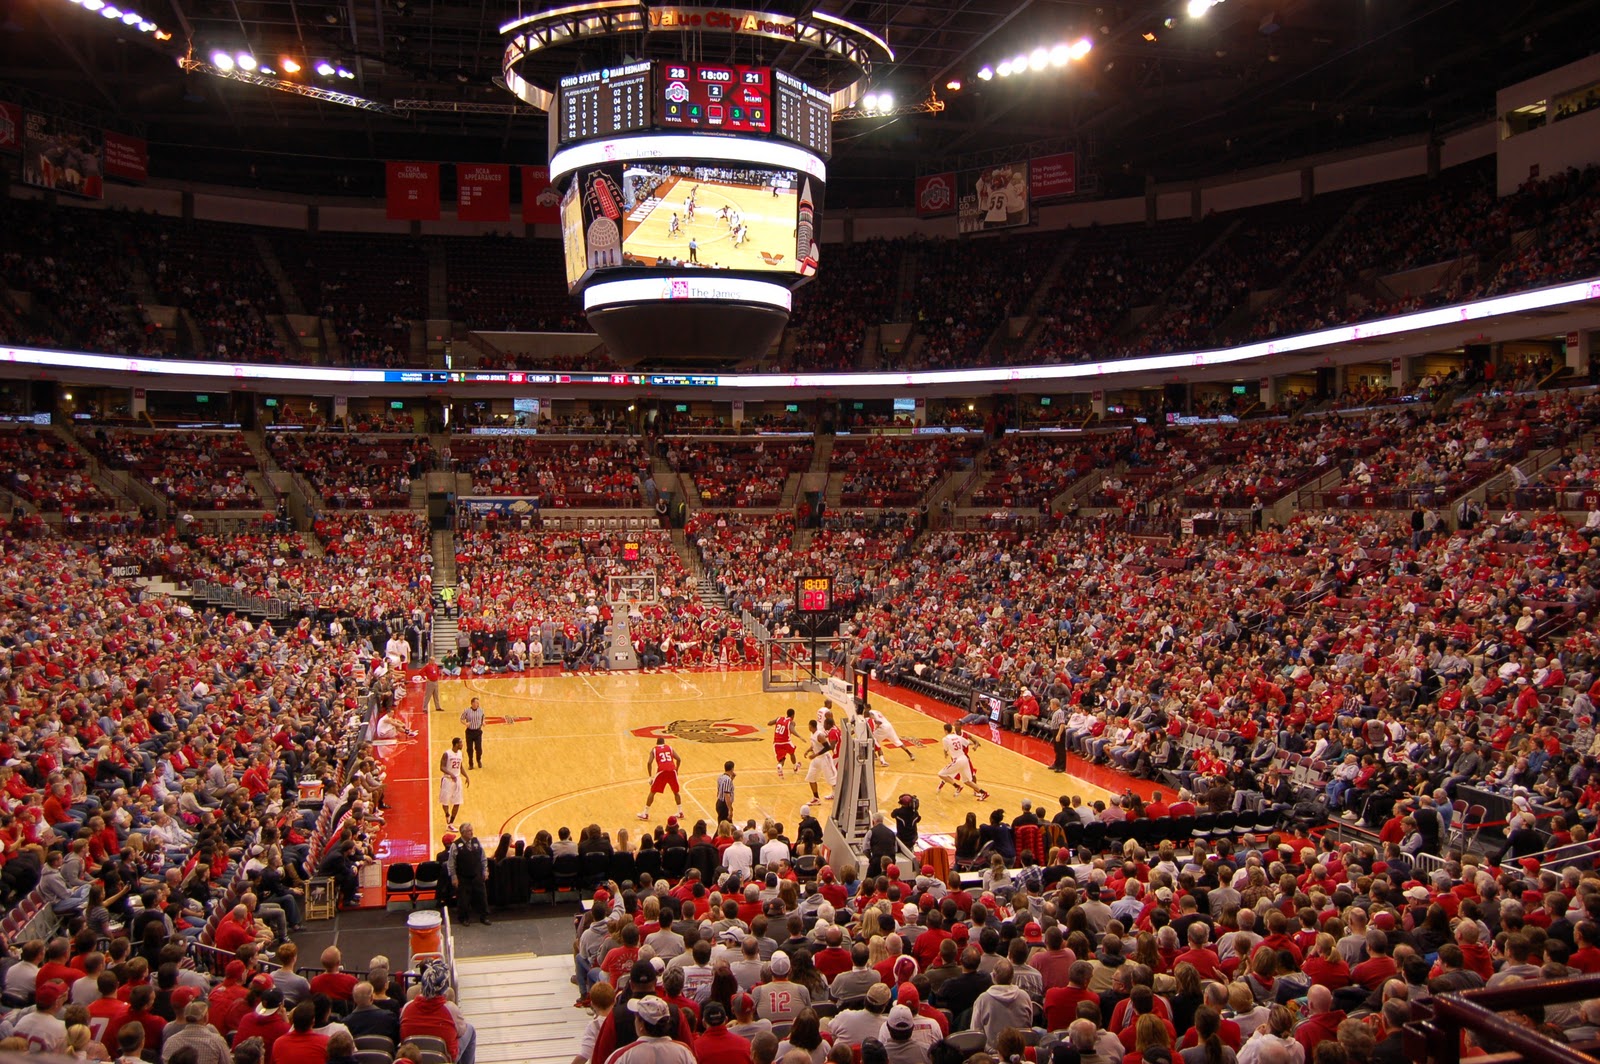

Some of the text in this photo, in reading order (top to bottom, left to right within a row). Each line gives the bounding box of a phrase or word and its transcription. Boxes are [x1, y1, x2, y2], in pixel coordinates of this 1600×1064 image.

[650, 10, 795, 37] Value City Arena
[610, 68, 624, 78] MIAMI
[671, 69, 685, 78] 28
[701, 71, 729, 80] 18:00
[746, 74, 759, 83] 21
[561, 72, 600, 87] OHIO STATE
[776, 72, 802, 90] OHIO STATE
[990, 197, 1004, 210] 55
[691, 288, 740, 298] The James
[804, 579, 828, 590] 18:00
[804, 591, 825, 610] 28
[776, 724, 785, 734] 20
[659, 752, 672, 762] 35
[769, 992, 791, 1012] 12
[90, 1017, 109, 1041] 7
